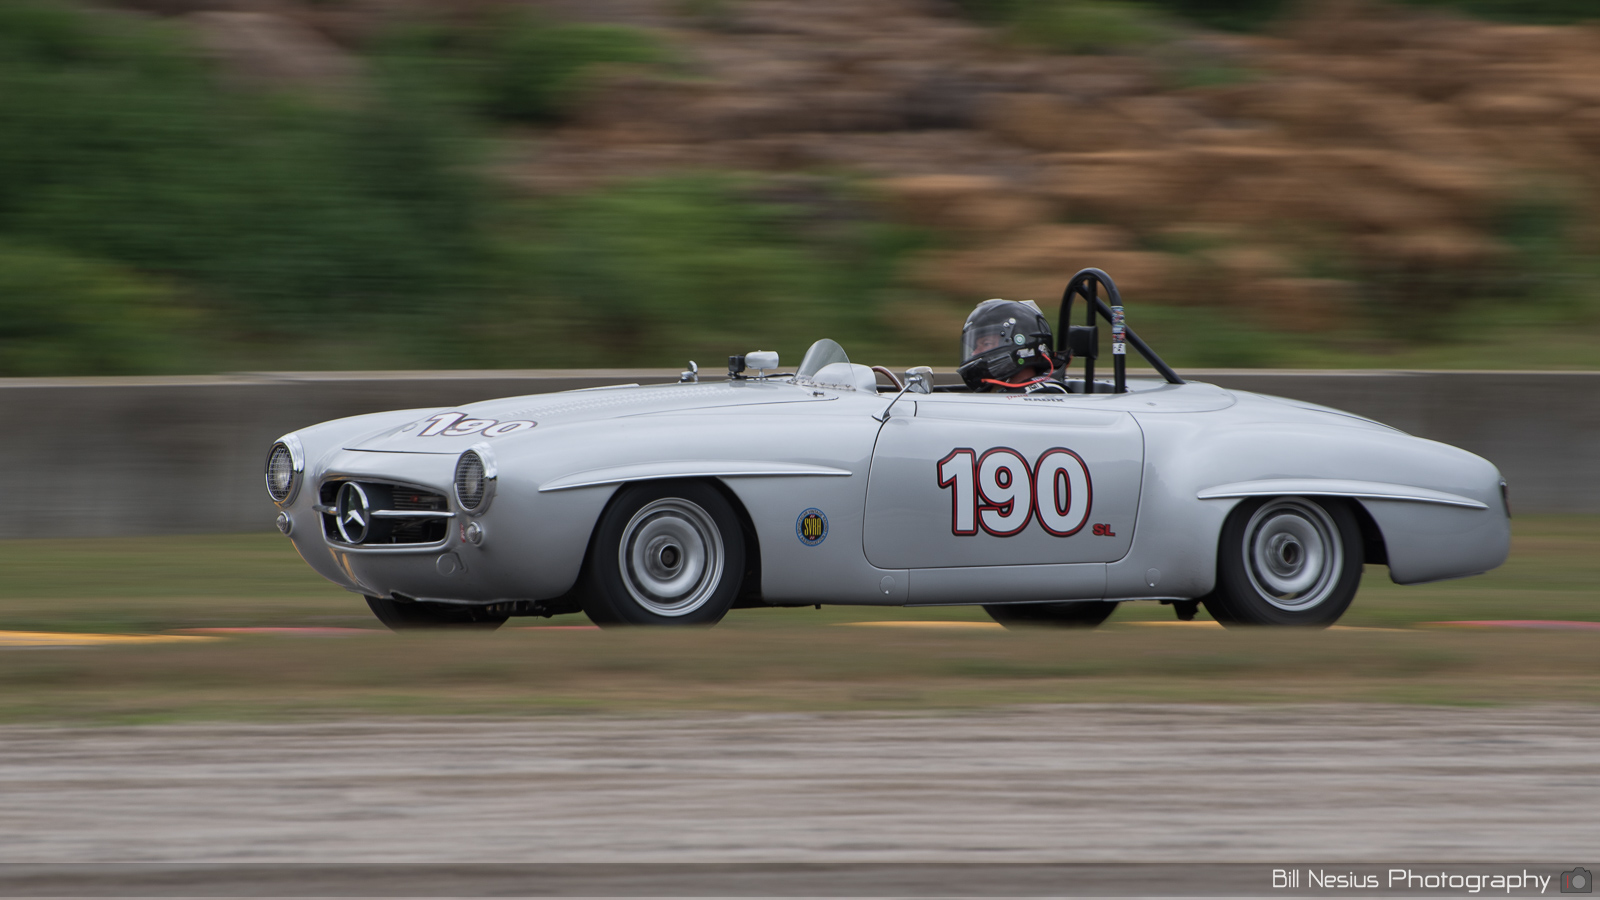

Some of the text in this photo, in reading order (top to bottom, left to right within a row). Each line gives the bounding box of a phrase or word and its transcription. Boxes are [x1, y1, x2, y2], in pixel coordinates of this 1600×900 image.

[417, 411, 538, 437] 190
[937, 446, 1093, 538] 190
[804, 517, 822, 536] SVRA
[1092, 523, 1116, 537] SL
